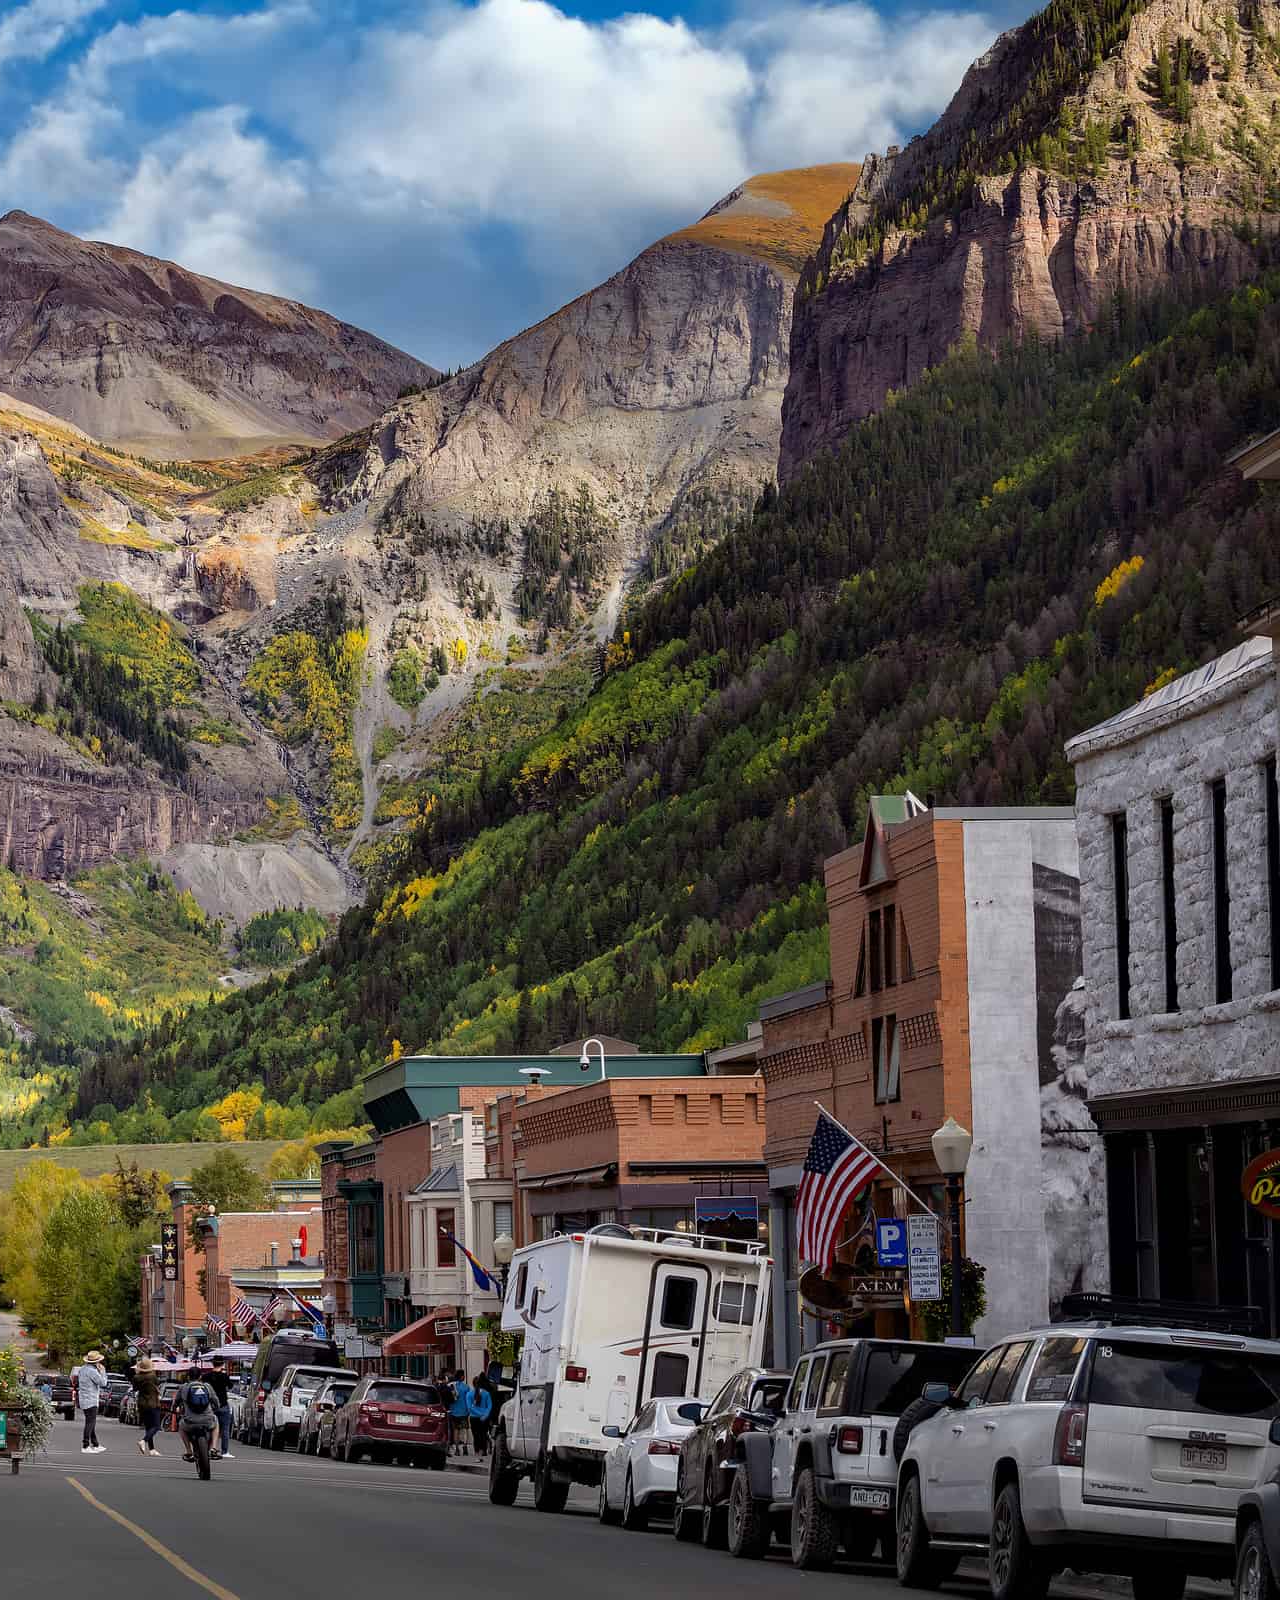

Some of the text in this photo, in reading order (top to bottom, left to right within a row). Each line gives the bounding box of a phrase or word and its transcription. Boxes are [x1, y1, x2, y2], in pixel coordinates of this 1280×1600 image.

[880, 1225, 901, 1250] P
[1099, 1346, 1113, 1358] 18
[1189, 1431, 1227, 1442] GMC
